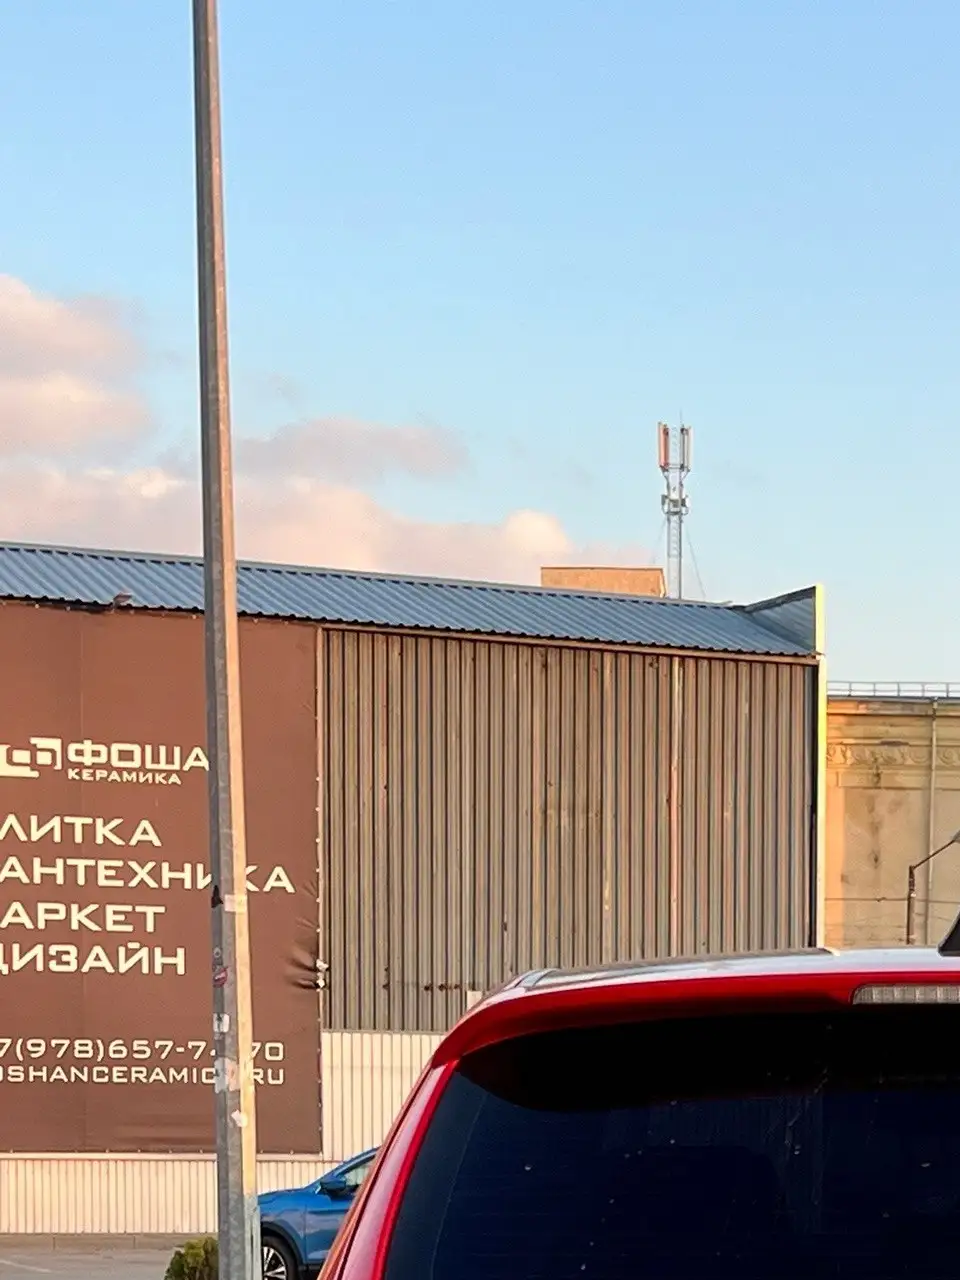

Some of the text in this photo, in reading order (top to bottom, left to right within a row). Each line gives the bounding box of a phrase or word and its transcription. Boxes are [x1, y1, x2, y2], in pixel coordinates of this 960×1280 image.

[67, 768, 182, 785] КЕРАМИКА
[0, 902, 166, 933] АРКЕТ
[0, 942, 185, 975] ИЗАЙН
